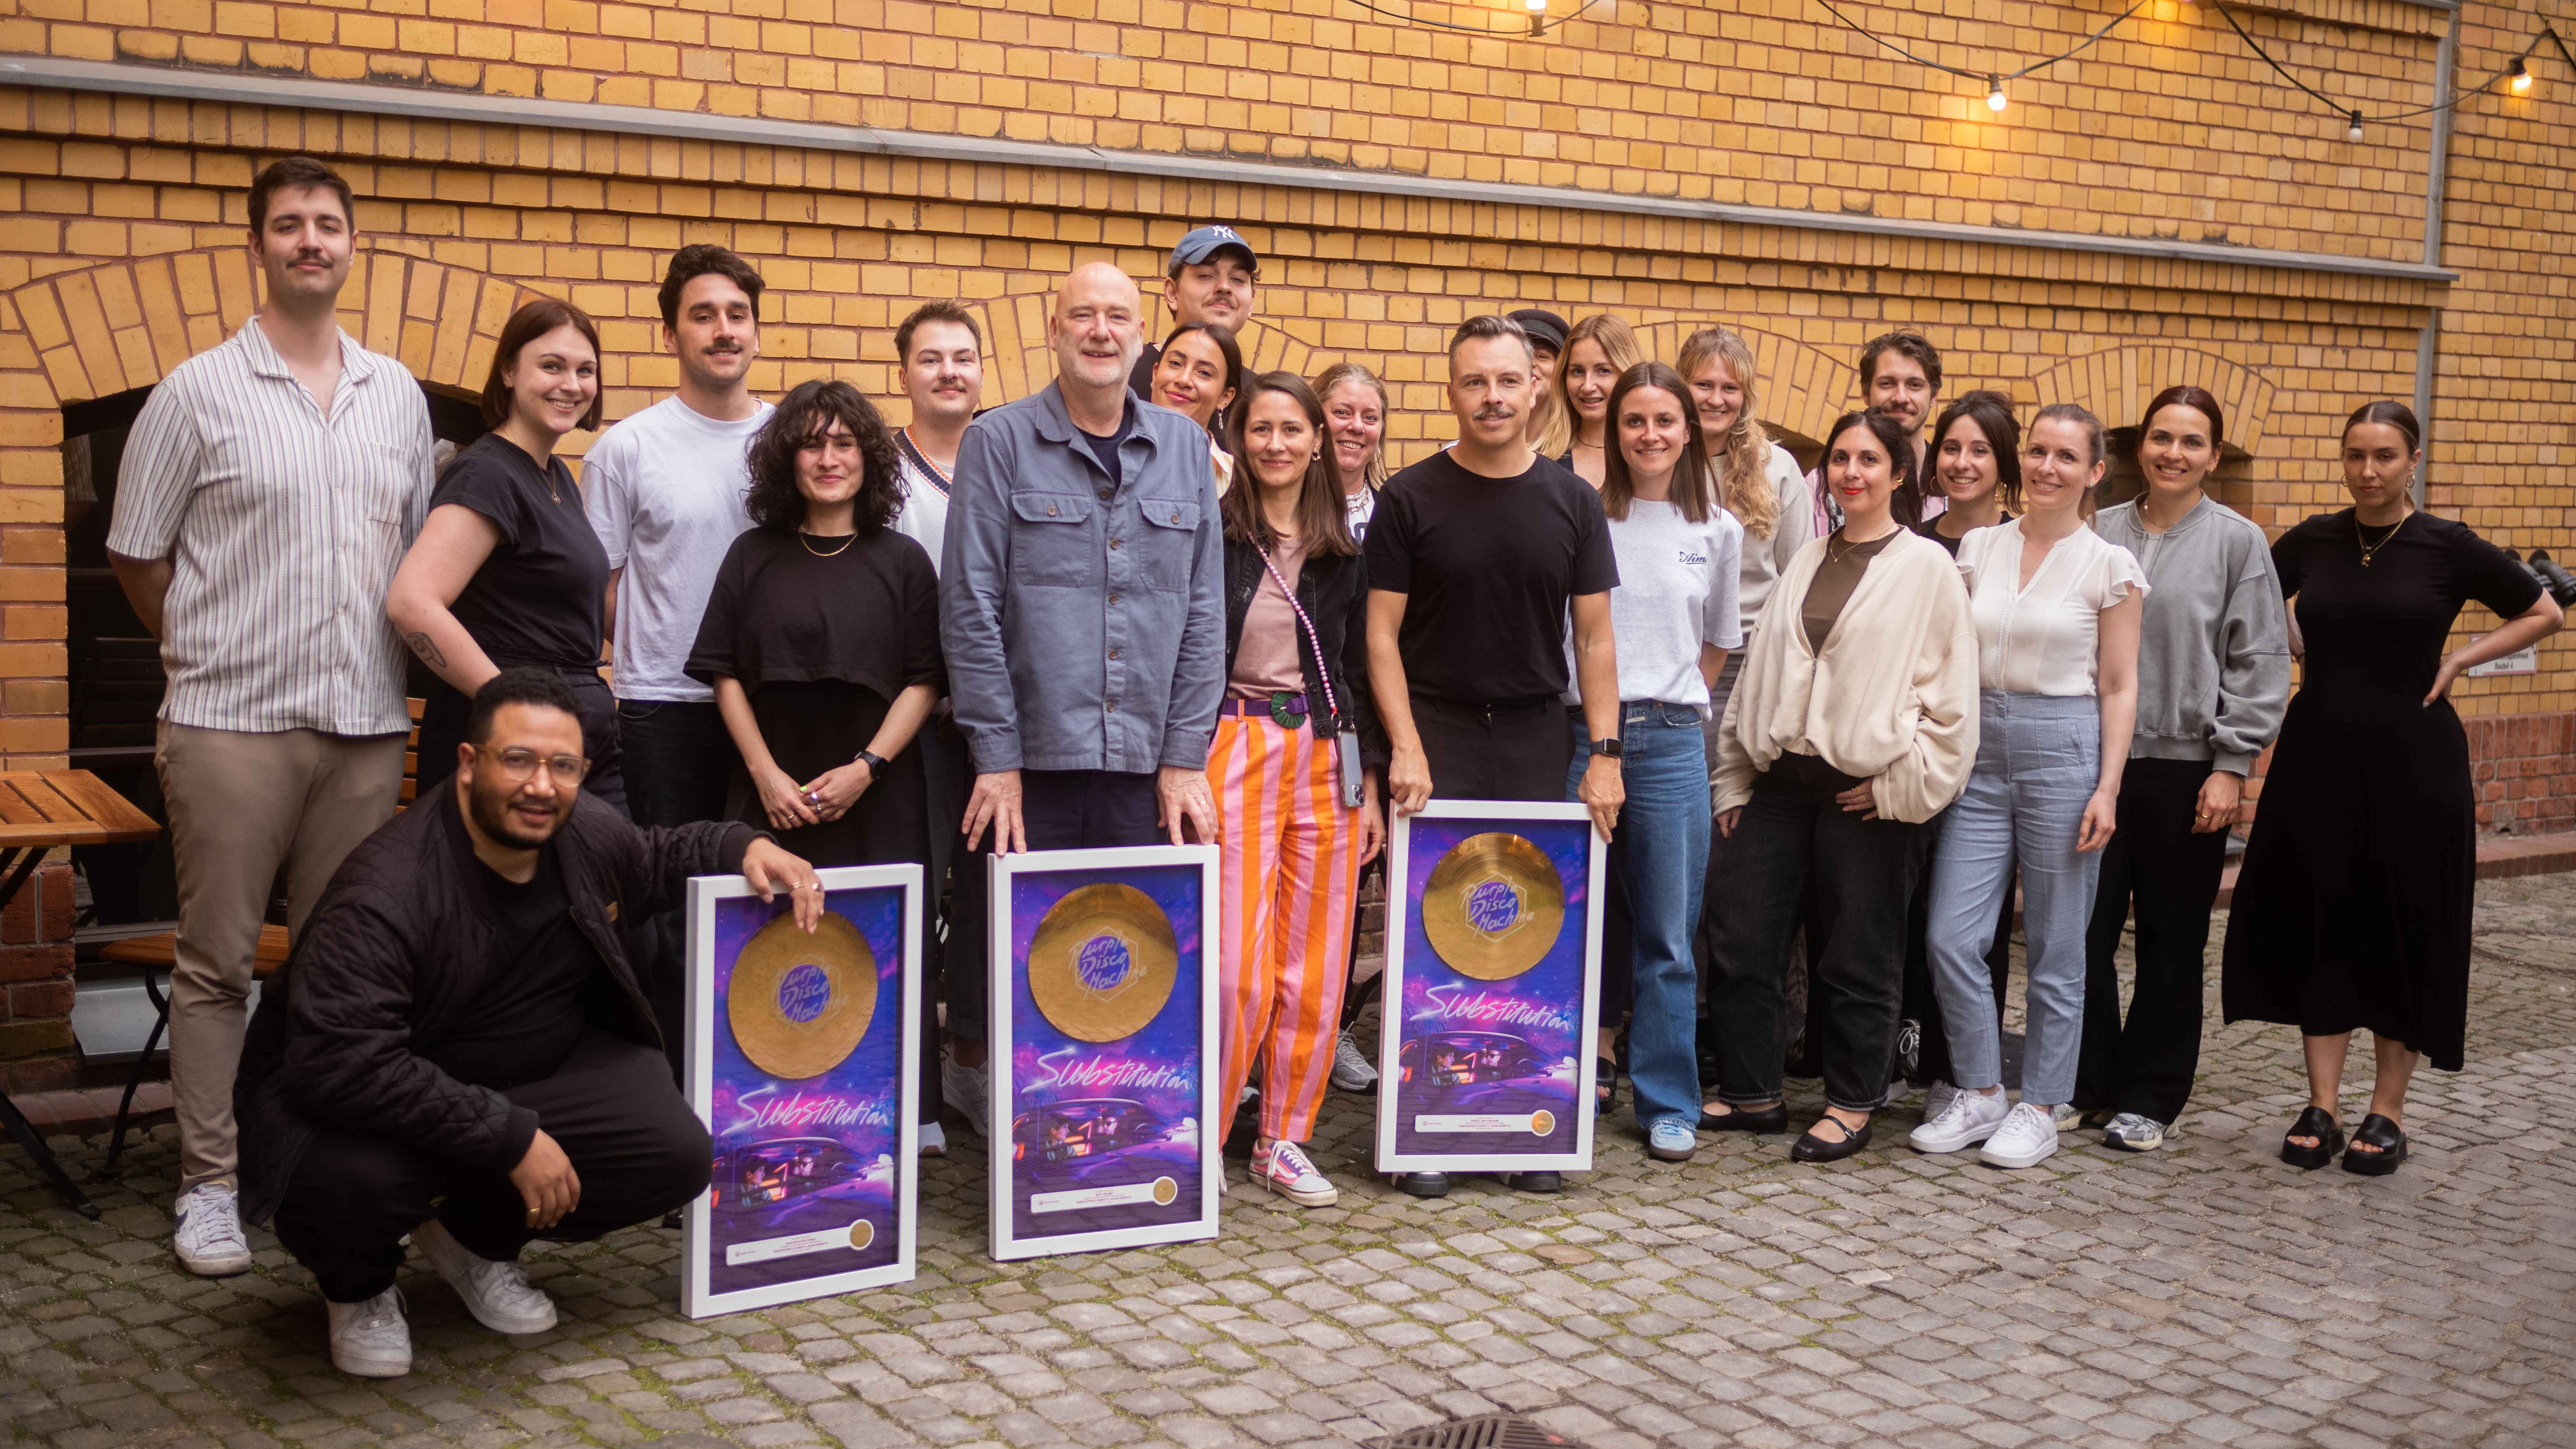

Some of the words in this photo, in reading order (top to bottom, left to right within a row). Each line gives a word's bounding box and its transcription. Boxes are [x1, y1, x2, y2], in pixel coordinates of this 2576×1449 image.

[1212, 226, 1234, 239] NY
[1679, 551, 1707, 563] Aim
[1459, 876, 1518, 911] Purple
[1467, 897, 1517, 923] Disco
[1472, 908, 1535, 939] Machine
[1067, 929, 1129, 971] Purple
[1077, 951, 1128, 983] Disco
[781, 980, 830, 1014] Disco
[1083, 963, 1147, 1001] Machine
[785, 991, 850, 1034] Machine
[1409, 983, 1569, 1030] Substitution
[1021, 1048, 1189, 1093] Substitution
[720, 1086, 889, 1136] Substitution
